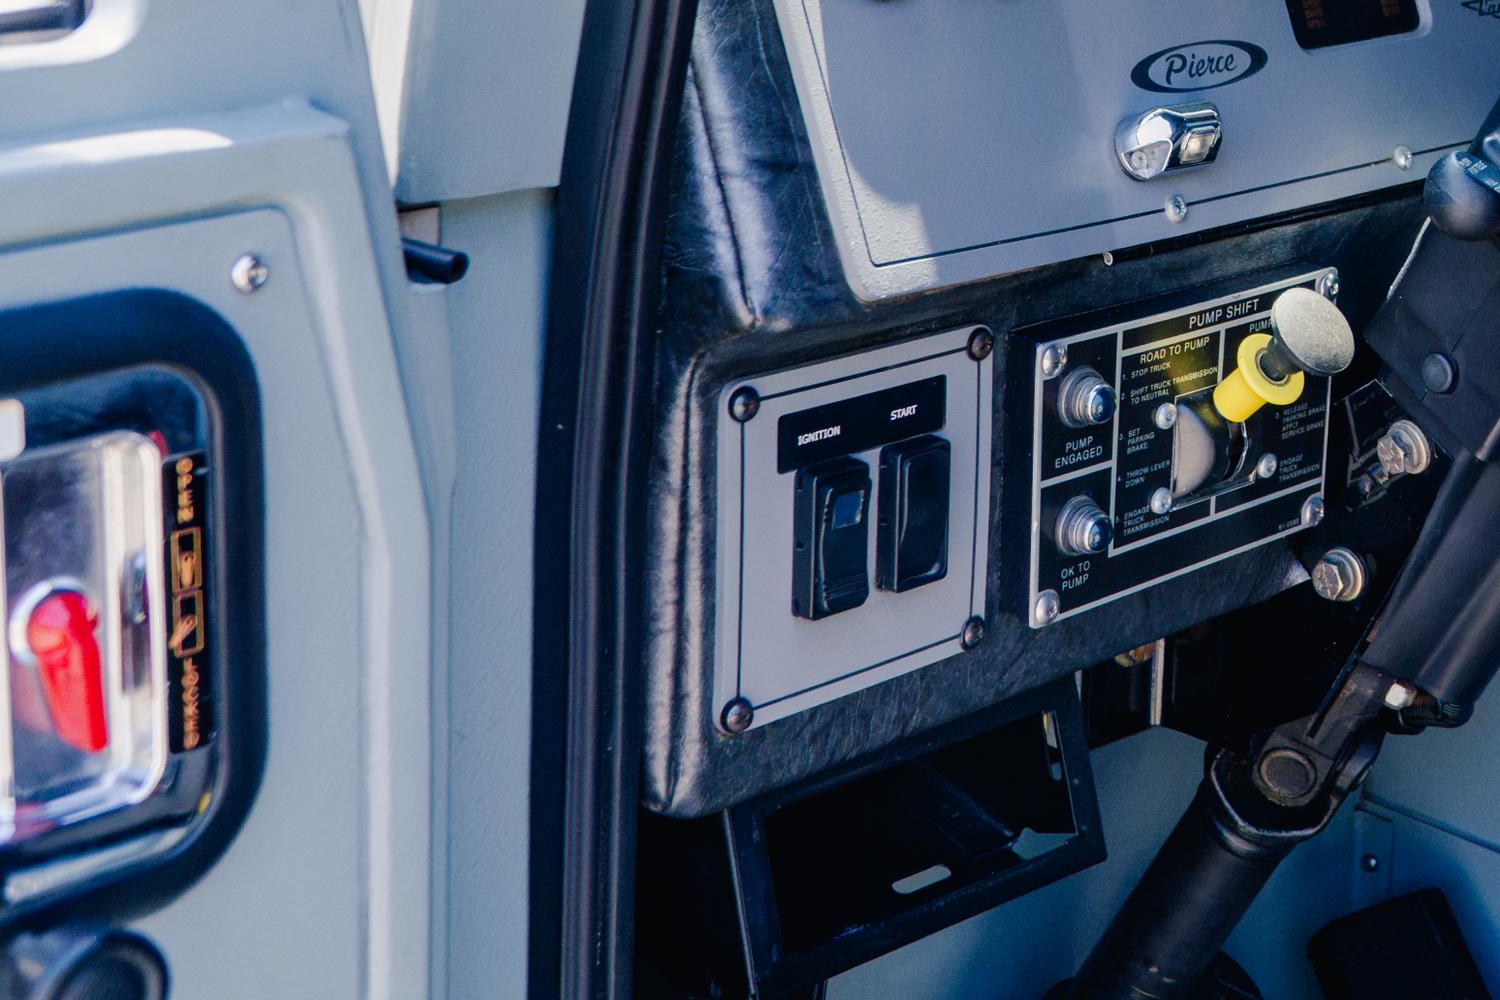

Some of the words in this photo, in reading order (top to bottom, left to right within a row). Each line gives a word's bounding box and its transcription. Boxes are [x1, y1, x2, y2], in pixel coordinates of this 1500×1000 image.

[1165, 53, 1238, 85] Pierce
[1189, 309, 1222, 329] PUMP
[1226, 299, 1259, 319] SHIFT
[1140, 348, 1167, 364] ROAD
[1169, 345, 1181, 356] TO
[1184, 336, 1210, 352] PUMP
[1131, 367, 1148, 379] STOP
[1150, 361, 1171, 373] TRUCK
[1130, 386, 1149, 398] SHIFT
[1150, 379, 1171, 391] TRUCK
[1172, 366, 1218, 385] TRANSMISSION
[1141, 388, 1169, 401] NEUTRAL
[890, 404, 918, 421] START
[797, 425, 841, 446] IGNITION
[1127, 431, 1155, 446] PARKING
[1128, 428, 1140, 438] SET
[1065, 435, 1094, 452] PUMP
[1126, 442, 1148, 455] BRAKE
[1055, 445, 1103, 469] ENGAGED
[1126, 466, 1149, 479] THROW
[1150, 460, 1171, 473] LEVER
[1125, 476, 1145, 488] DOWN
[1124, 505, 1151, 520] ENGAGE
[1123, 515, 1170, 537] TRANSMISSION
[1060, 565, 1075, 580] OK
[1078, 560, 1091, 572] TO
[1062, 573, 1089, 591] PUMP
